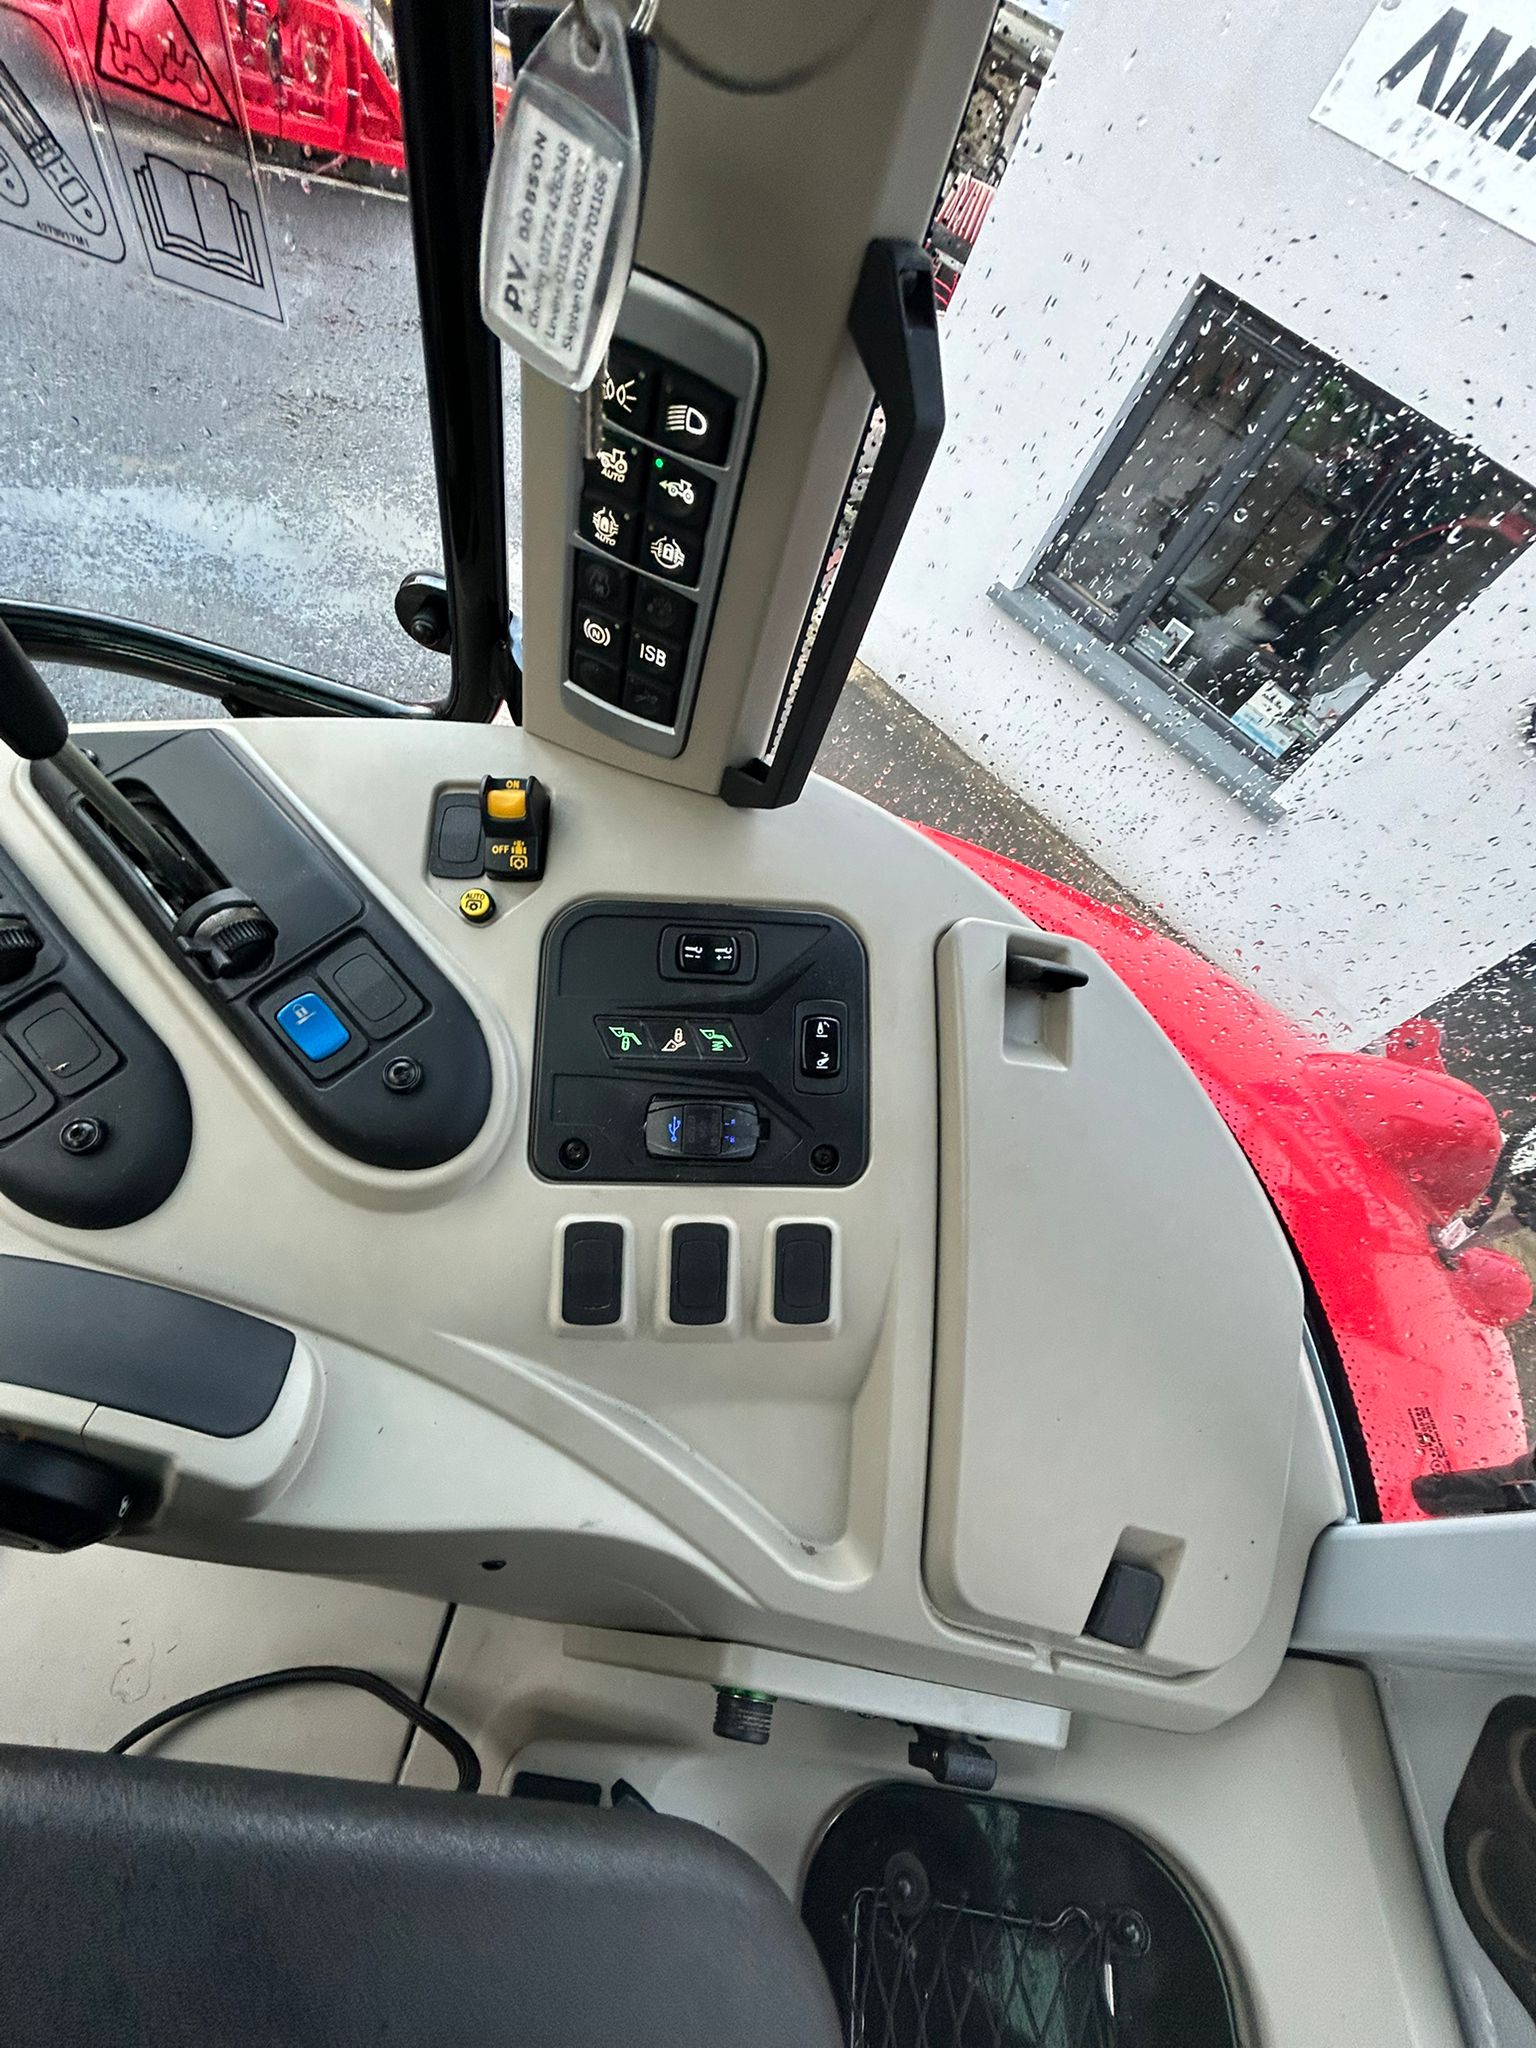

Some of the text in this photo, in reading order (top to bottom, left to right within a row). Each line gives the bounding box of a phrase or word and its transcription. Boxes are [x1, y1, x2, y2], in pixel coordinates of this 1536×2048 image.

[519, 131, 547, 241] DOBSON
[601, 467, 626, 483] AUTO
[594, 532, 616, 546] AUTO
[639, 642, 667, 668] ISB
[505, 779, 520, 789] ON
[491, 844, 510, 855] OFF
[465, 892, 486, 901] AUTO
